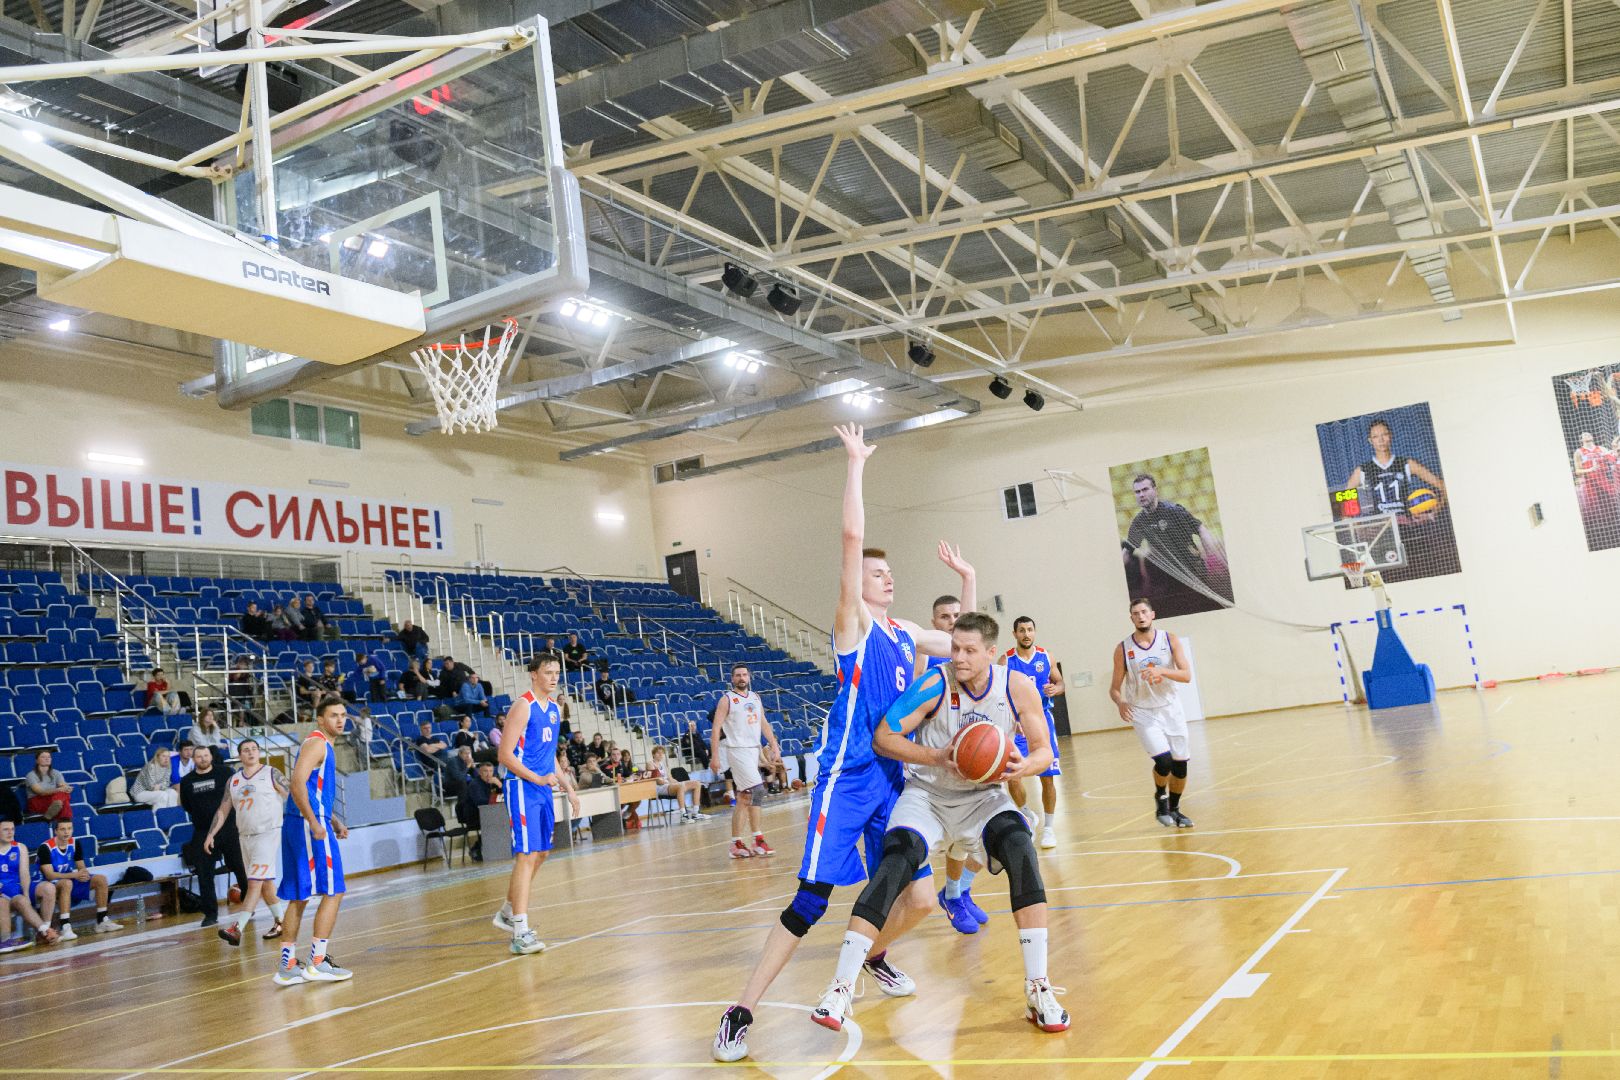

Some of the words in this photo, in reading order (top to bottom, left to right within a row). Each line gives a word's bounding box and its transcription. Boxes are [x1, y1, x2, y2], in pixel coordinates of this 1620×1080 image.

[1374, 480, 1401, 503] 11
[5, 470, 202, 535] ВЫШЕ!
[225, 490, 443, 550] СИЛЬНЕЕ!
[895, 665, 906, 692] 6
[542, 726, 553, 743] 10
[239, 798, 254, 812] 77
[250, 863, 269, 876] 77
